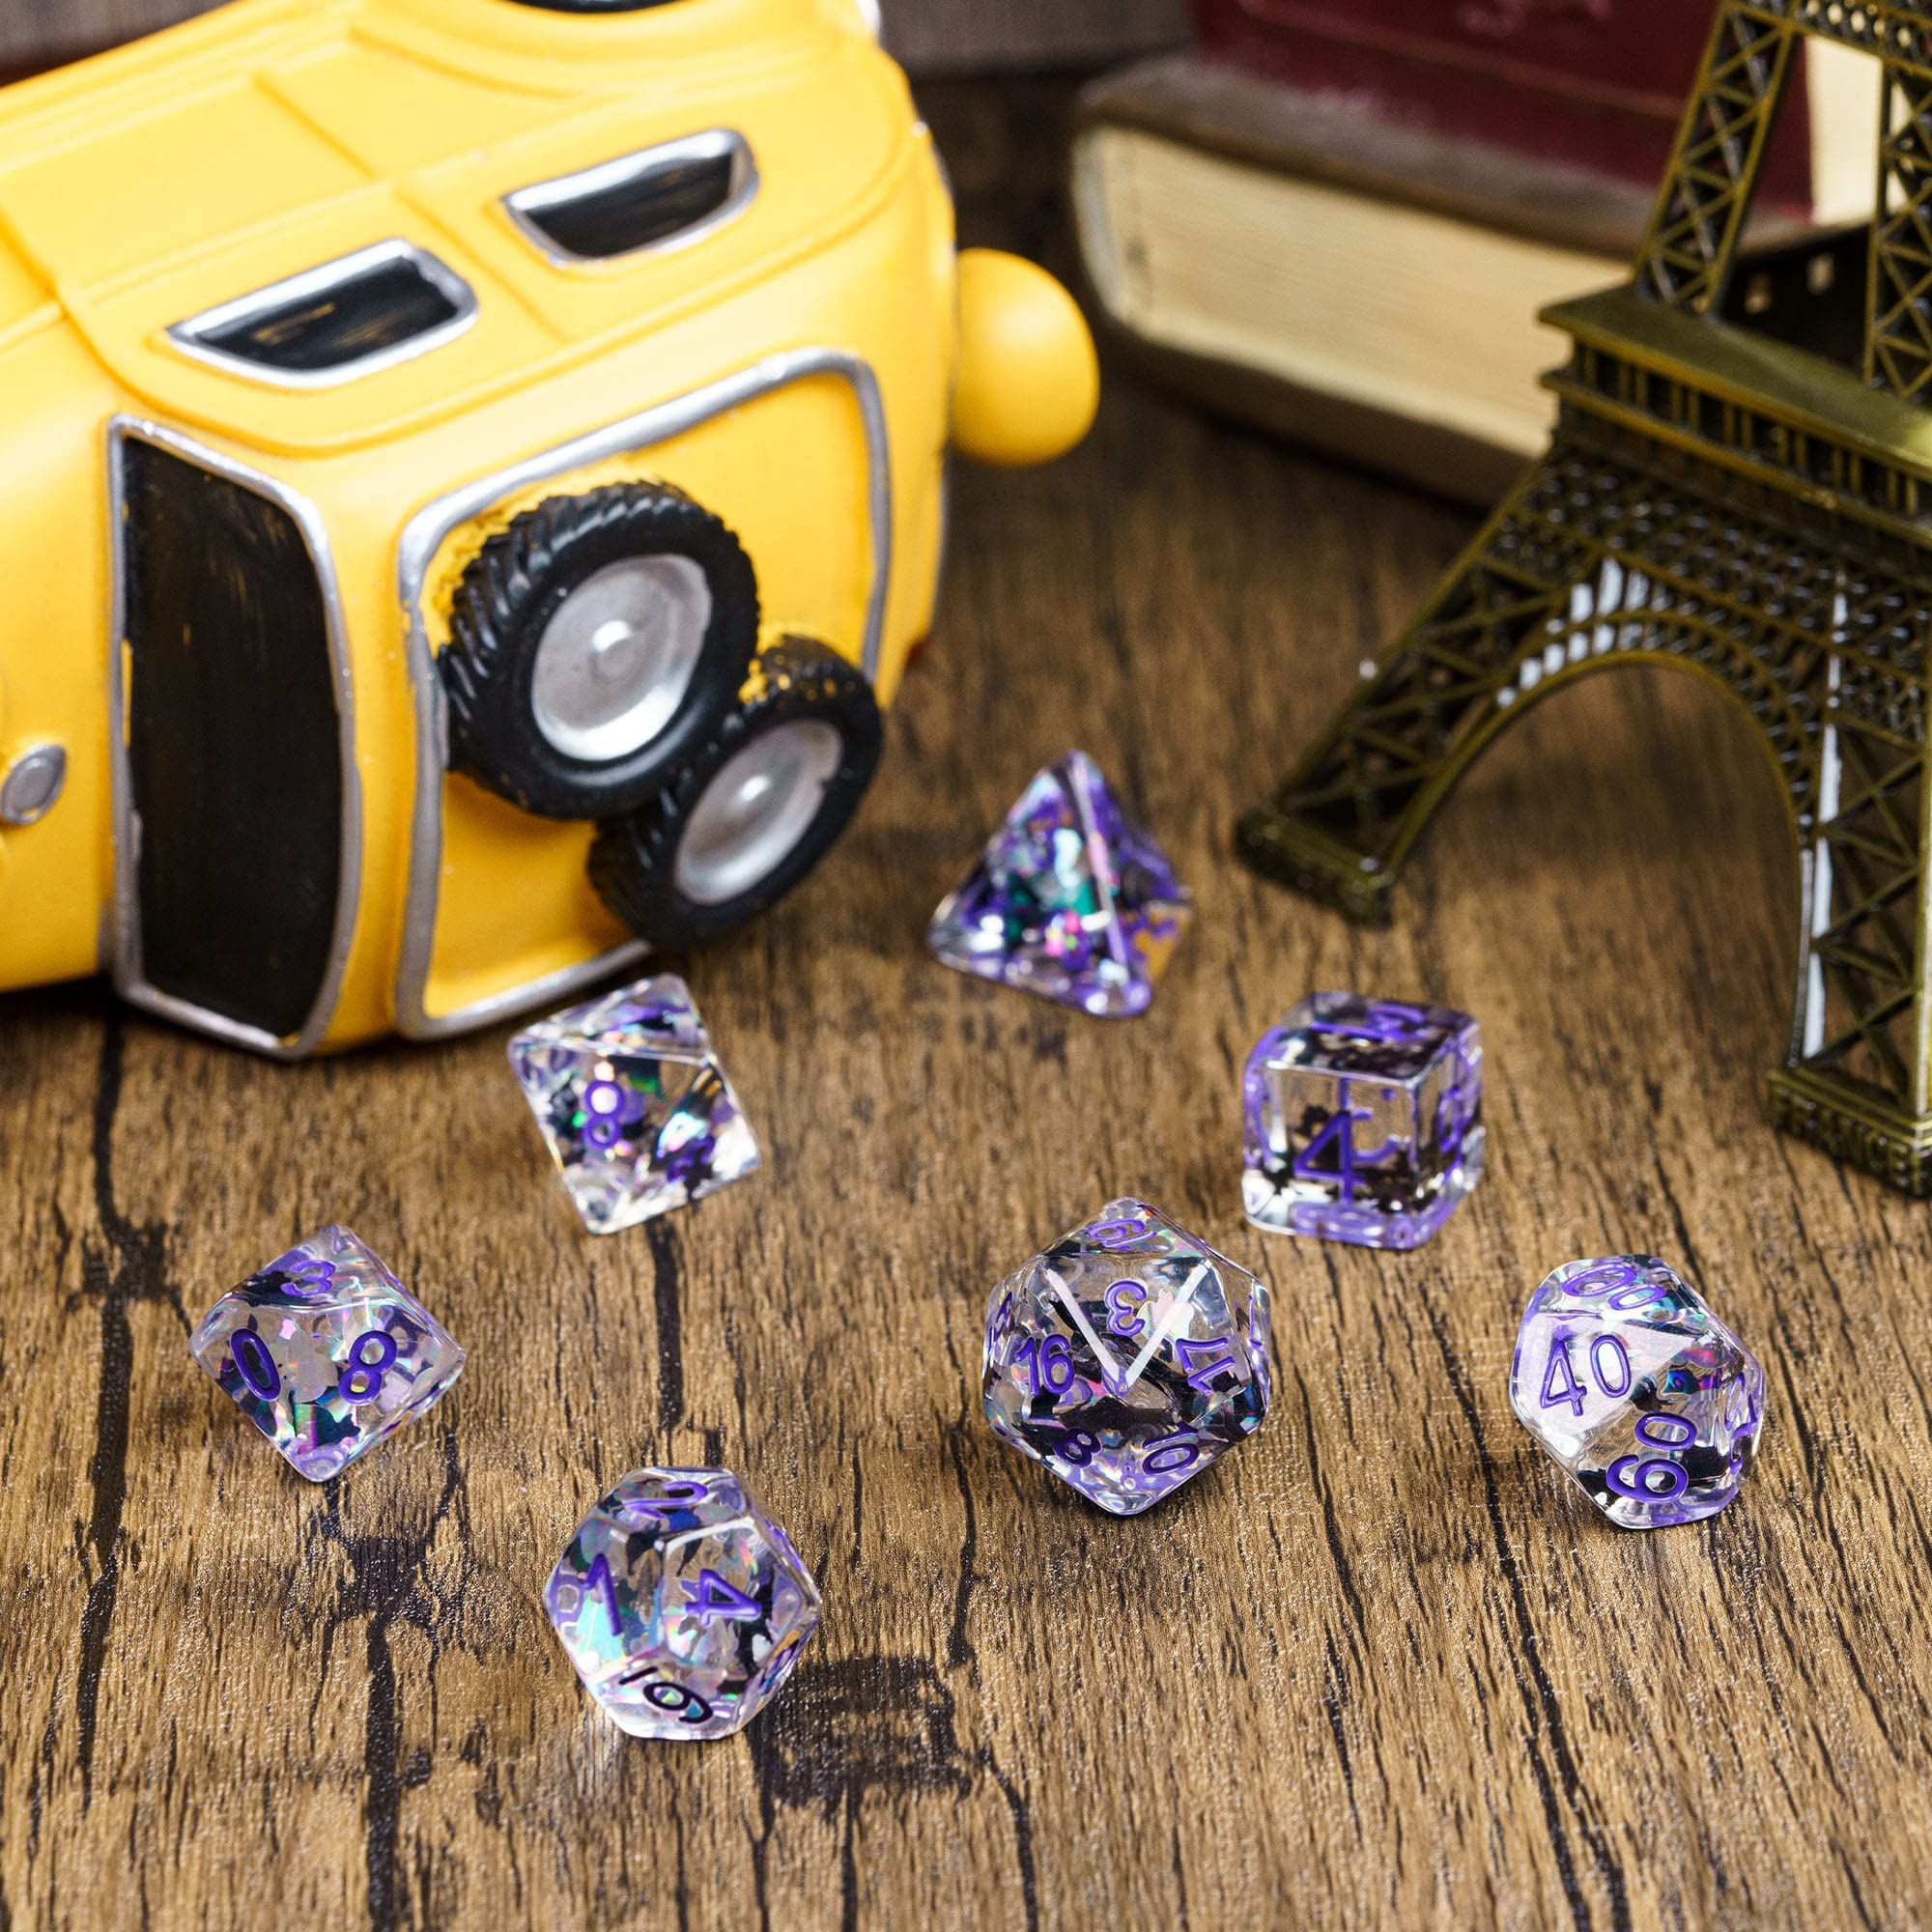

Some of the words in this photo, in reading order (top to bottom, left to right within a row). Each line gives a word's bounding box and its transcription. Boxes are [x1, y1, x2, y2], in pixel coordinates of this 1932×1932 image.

[582, 1079, 624, 1150] 8
[1293, 1110, 1366, 1205] 4
[281, 1260, 336, 1295] 3
[1104, 1280, 1148, 1337] 3
[230, 1327, 281, 1402] 0
[339, 1329, 398, 1405] 8
[1016, 1333, 1075, 1396] 16
[1540, 1334, 1631, 1417] 40
[1054, 1428, 1101, 1466] 8
[685, 1568, 762, 1627] 4
